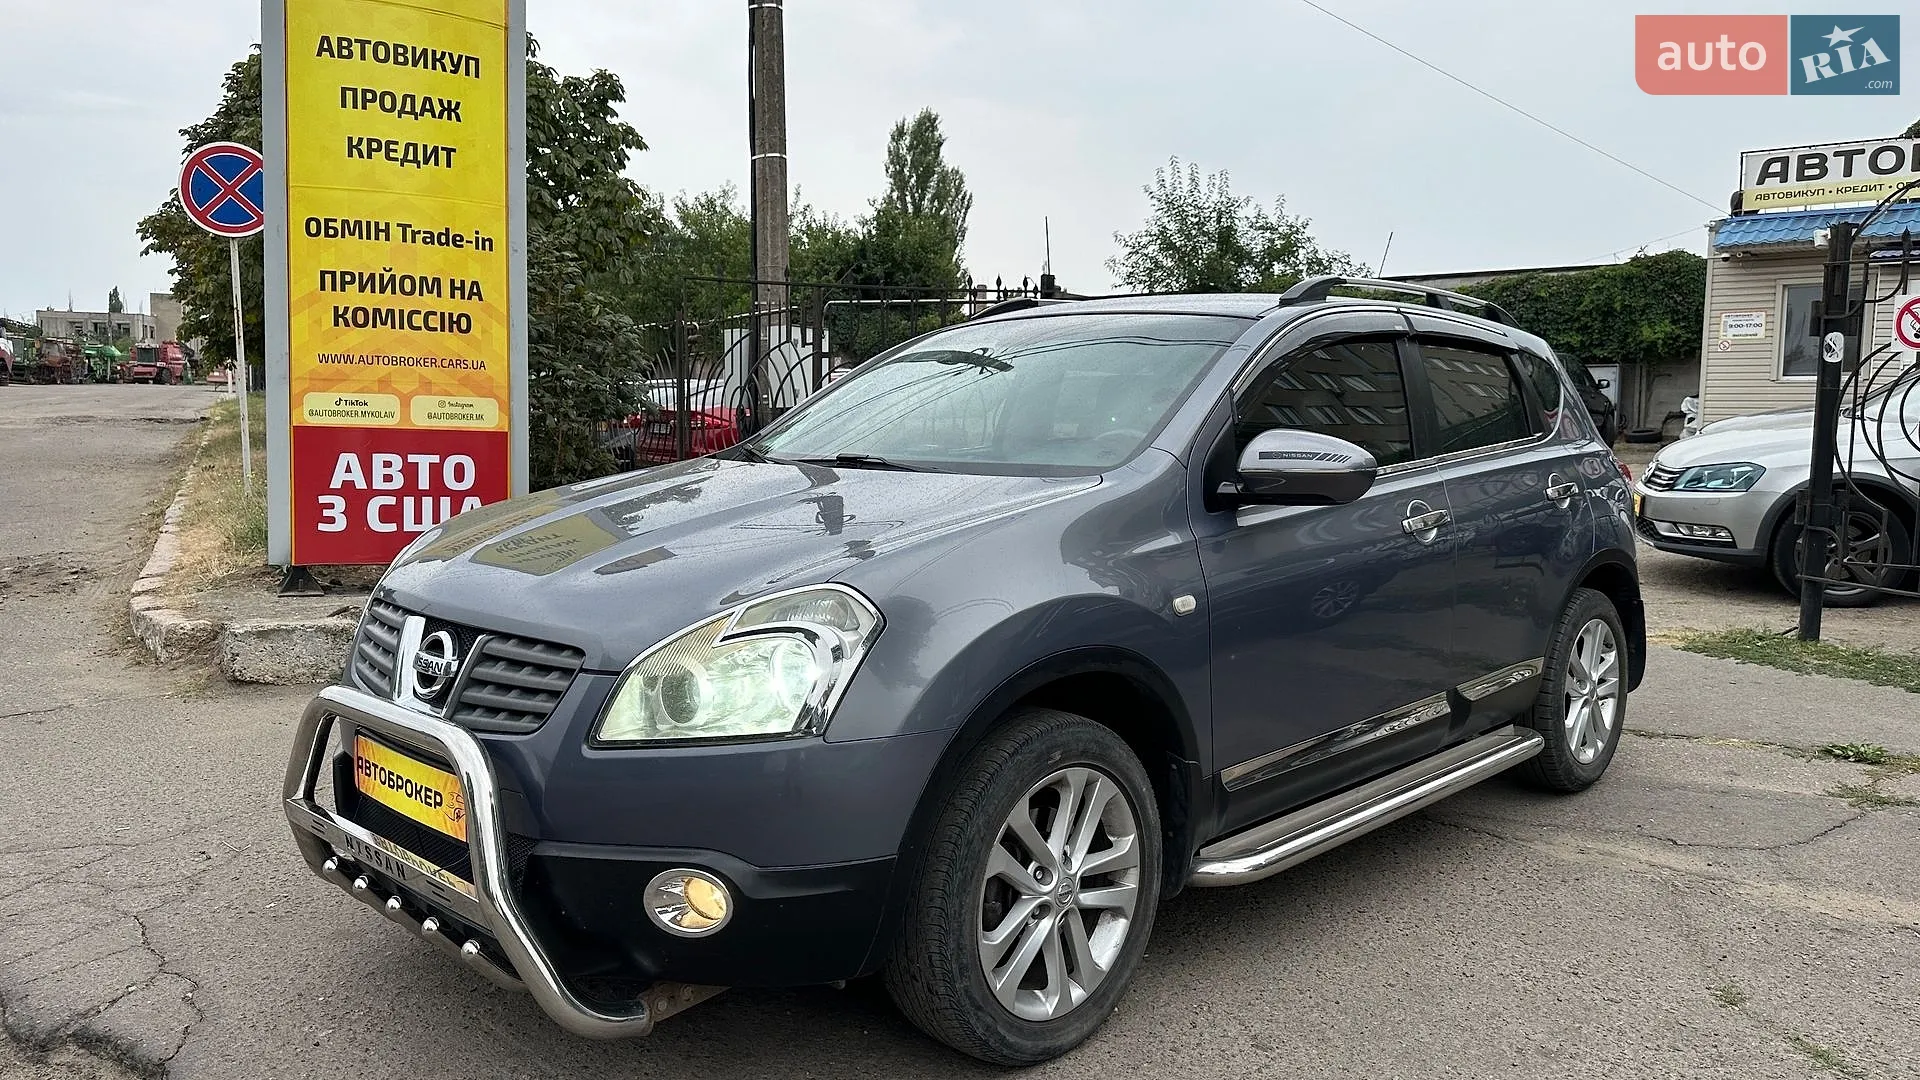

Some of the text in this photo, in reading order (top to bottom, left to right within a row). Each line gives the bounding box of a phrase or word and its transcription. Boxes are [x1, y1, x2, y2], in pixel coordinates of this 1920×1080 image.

[315, 35, 480, 79] АВТОВИКУП
[340, 86, 462, 122] ПРОДАЖ
[347, 136, 457, 169] КРЕДИТ
[1755, 144, 1920, 185] АВТО
[1755, 188, 1825, 201] АВТОВИКУП
[1836, 183, 1885, 195] КРЕДИТ
[304, 216, 494, 252] ОБМІН Trade-in
[319, 266, 484, 302] ПРИЙОМ НА
[333, 305, 472, 334] КОМІССІЮ
[317, 353, 487, 371] WWW.AUTOBROKER.CARS.UA
[308, 409, 396, 419] @AUTOBROKER.MYKOLAIV
[344, 399, 369, 407] TikTok
[448, 401, 475, 410] Instagram
[329, 452, 476, 491] АВТО
[317, 494, 348, 532] З
[415, 656, 443, 673] SSAN
[357, 755, 444, 809] АВТОБРОКЕР
[344, 834, 407, 881] NISSAN
